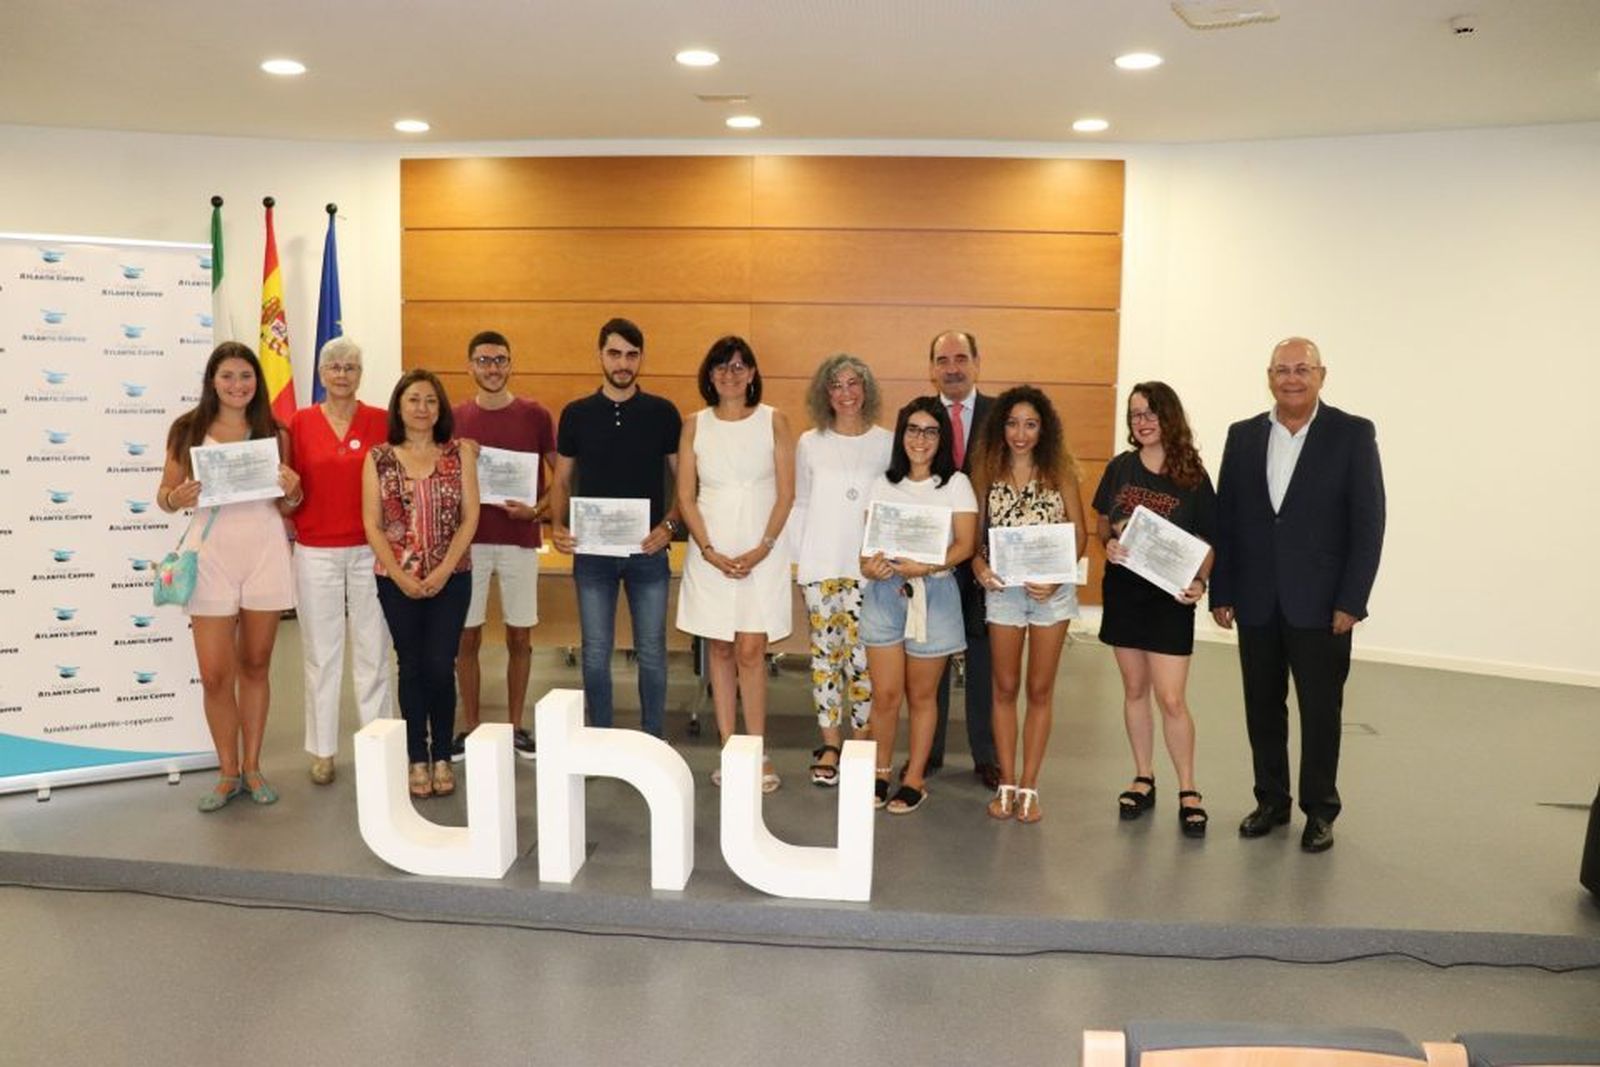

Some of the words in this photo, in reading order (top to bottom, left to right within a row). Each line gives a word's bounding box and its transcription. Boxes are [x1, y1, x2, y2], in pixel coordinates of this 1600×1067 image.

[38, 689, 72, 698] ATLANTIC
[73, 686, 100, 695] COPPER
[117, 695, 148, 703] ATLANTIC
[150, 692, 176, 700] COPPER
